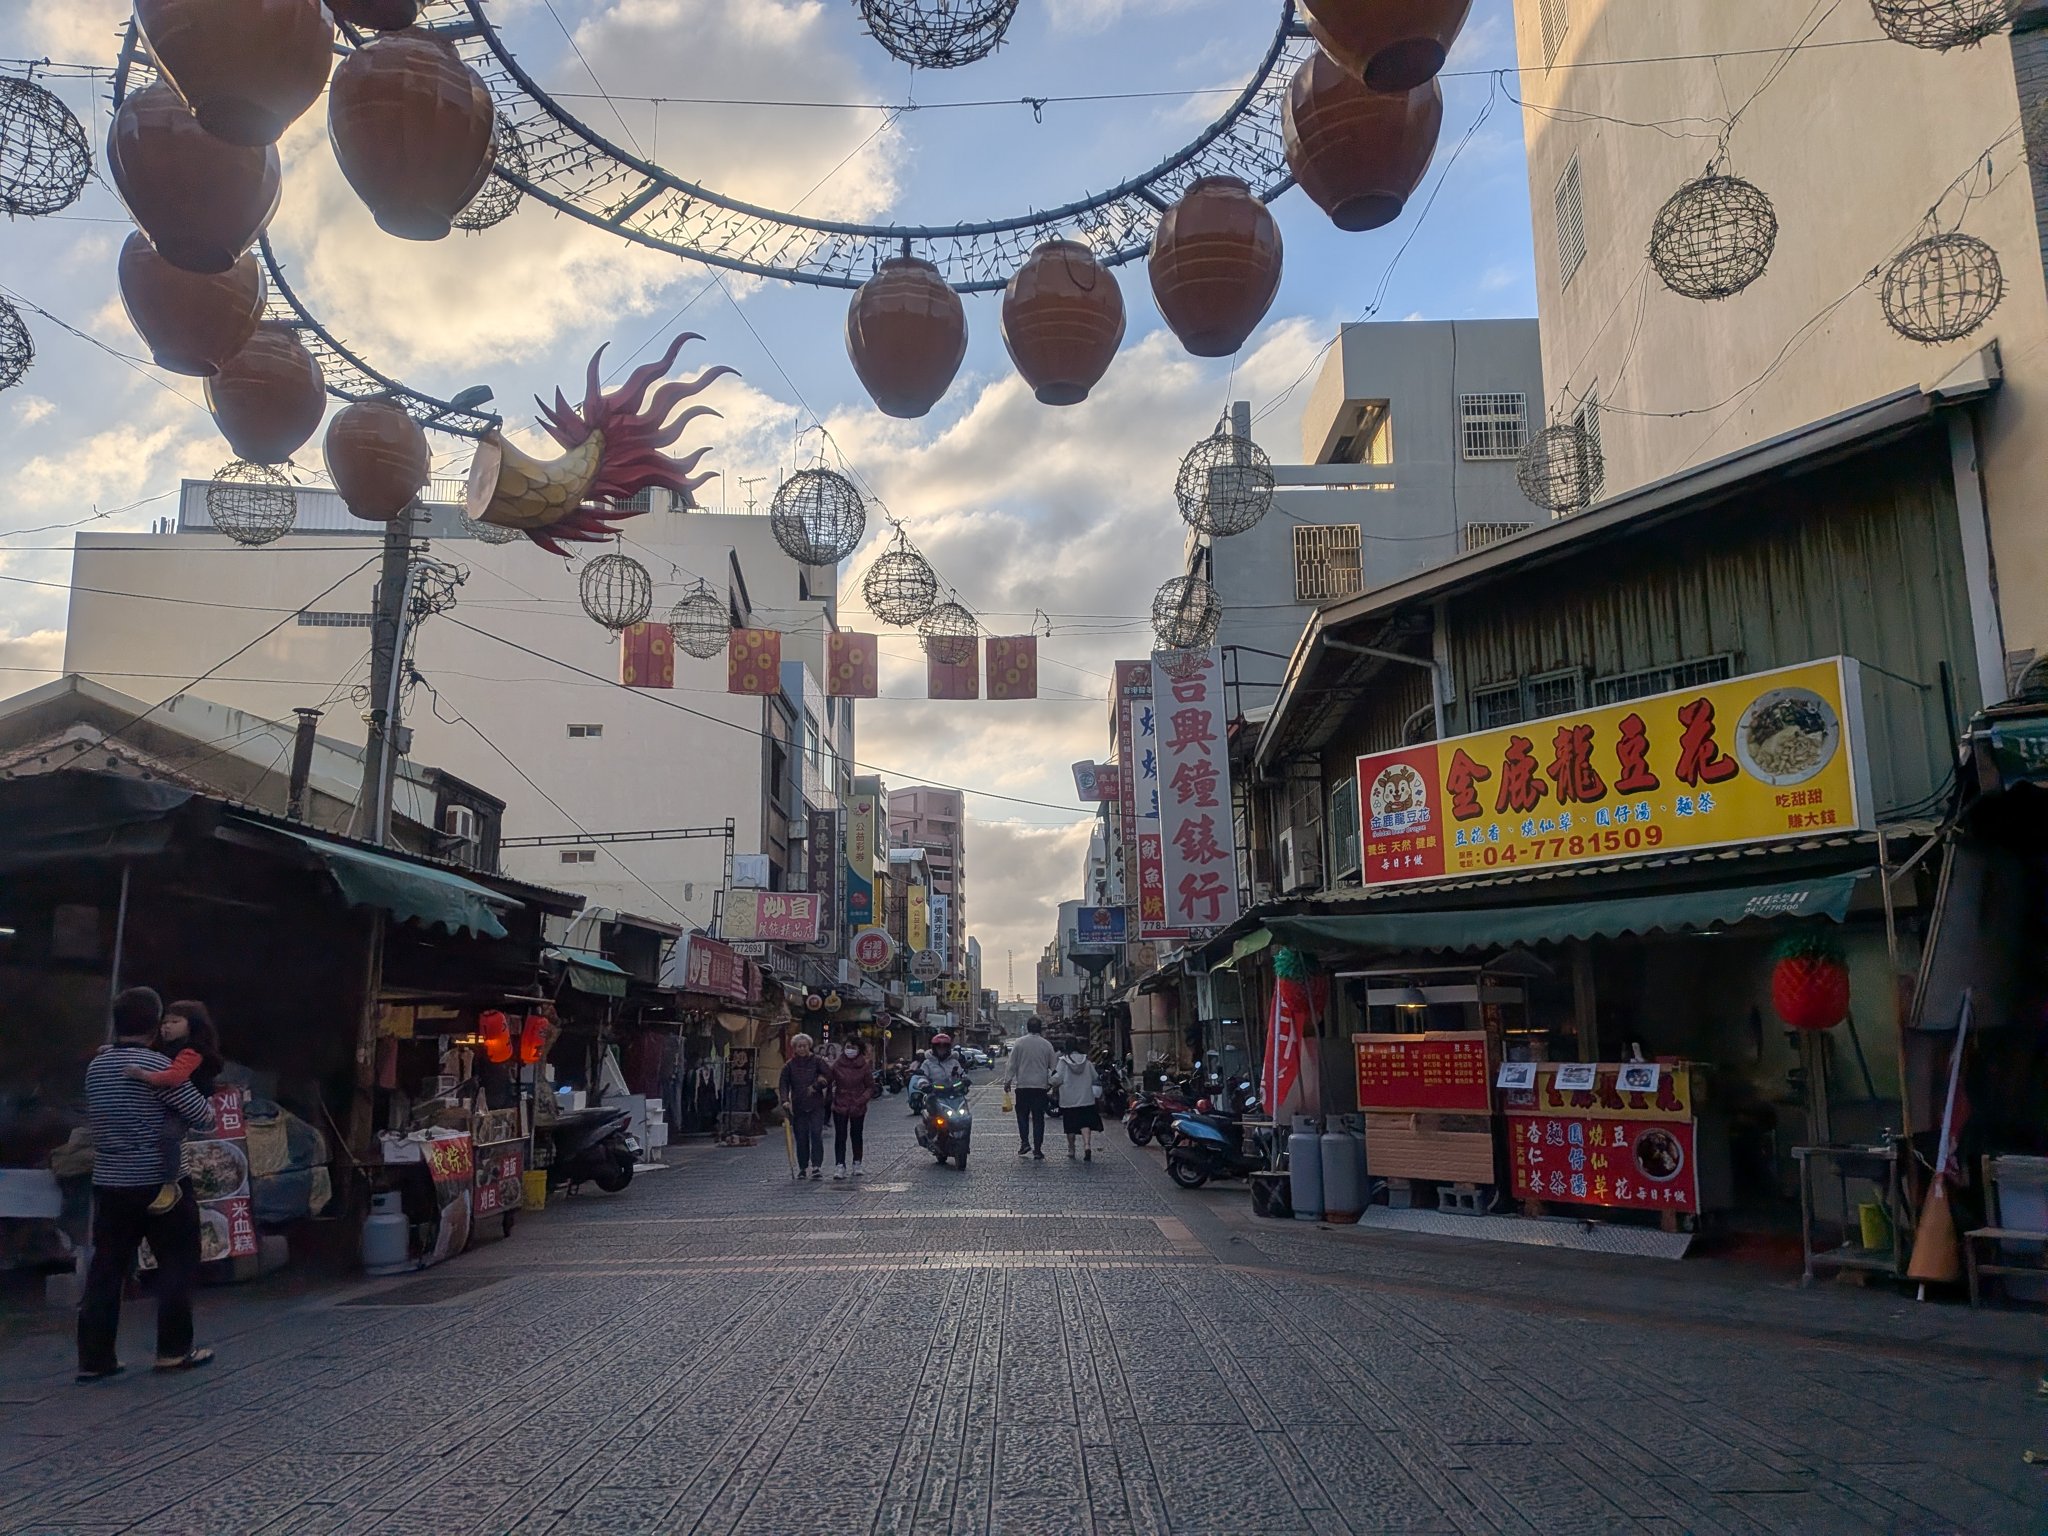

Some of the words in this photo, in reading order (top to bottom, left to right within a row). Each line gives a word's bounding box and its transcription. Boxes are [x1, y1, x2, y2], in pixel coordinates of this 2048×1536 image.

[1446, 697, 1739, 821] 金鹿龍豆花
[1775, 788, 1823, 808] 吃甜甜
[1371, 807, 1431, 830] 金鹿龍豆花
[1787, 809, 1837, 829] 賺大錢
[1367, 843, 1387, 856] 養生
[1391, 839, 1412, 853] 天然
[1416, 835, 1437, 849] 健康
[1381, 854, 1424, 871] 每日手做
[1483, 824, 1664, 866] 04-7781509
[219, 1093, 241, 1130] 刈包
[1527, 1121, 1545, 1194] 杏仁茶
[1546, 1122, 1567, 1196] 麵茶
[1568, 1123, 1588, 1198] 圓仔湯
[1589, 1124, 1609, 1199] 燒仙草
[1611, 1126, 1632, 1200] 豆花
[481, 1189, 496, 1210] 刈包
[1636, 1186, 1687, 1203] 每日手做
[231, 1201, 254, 1252] 米血糕
